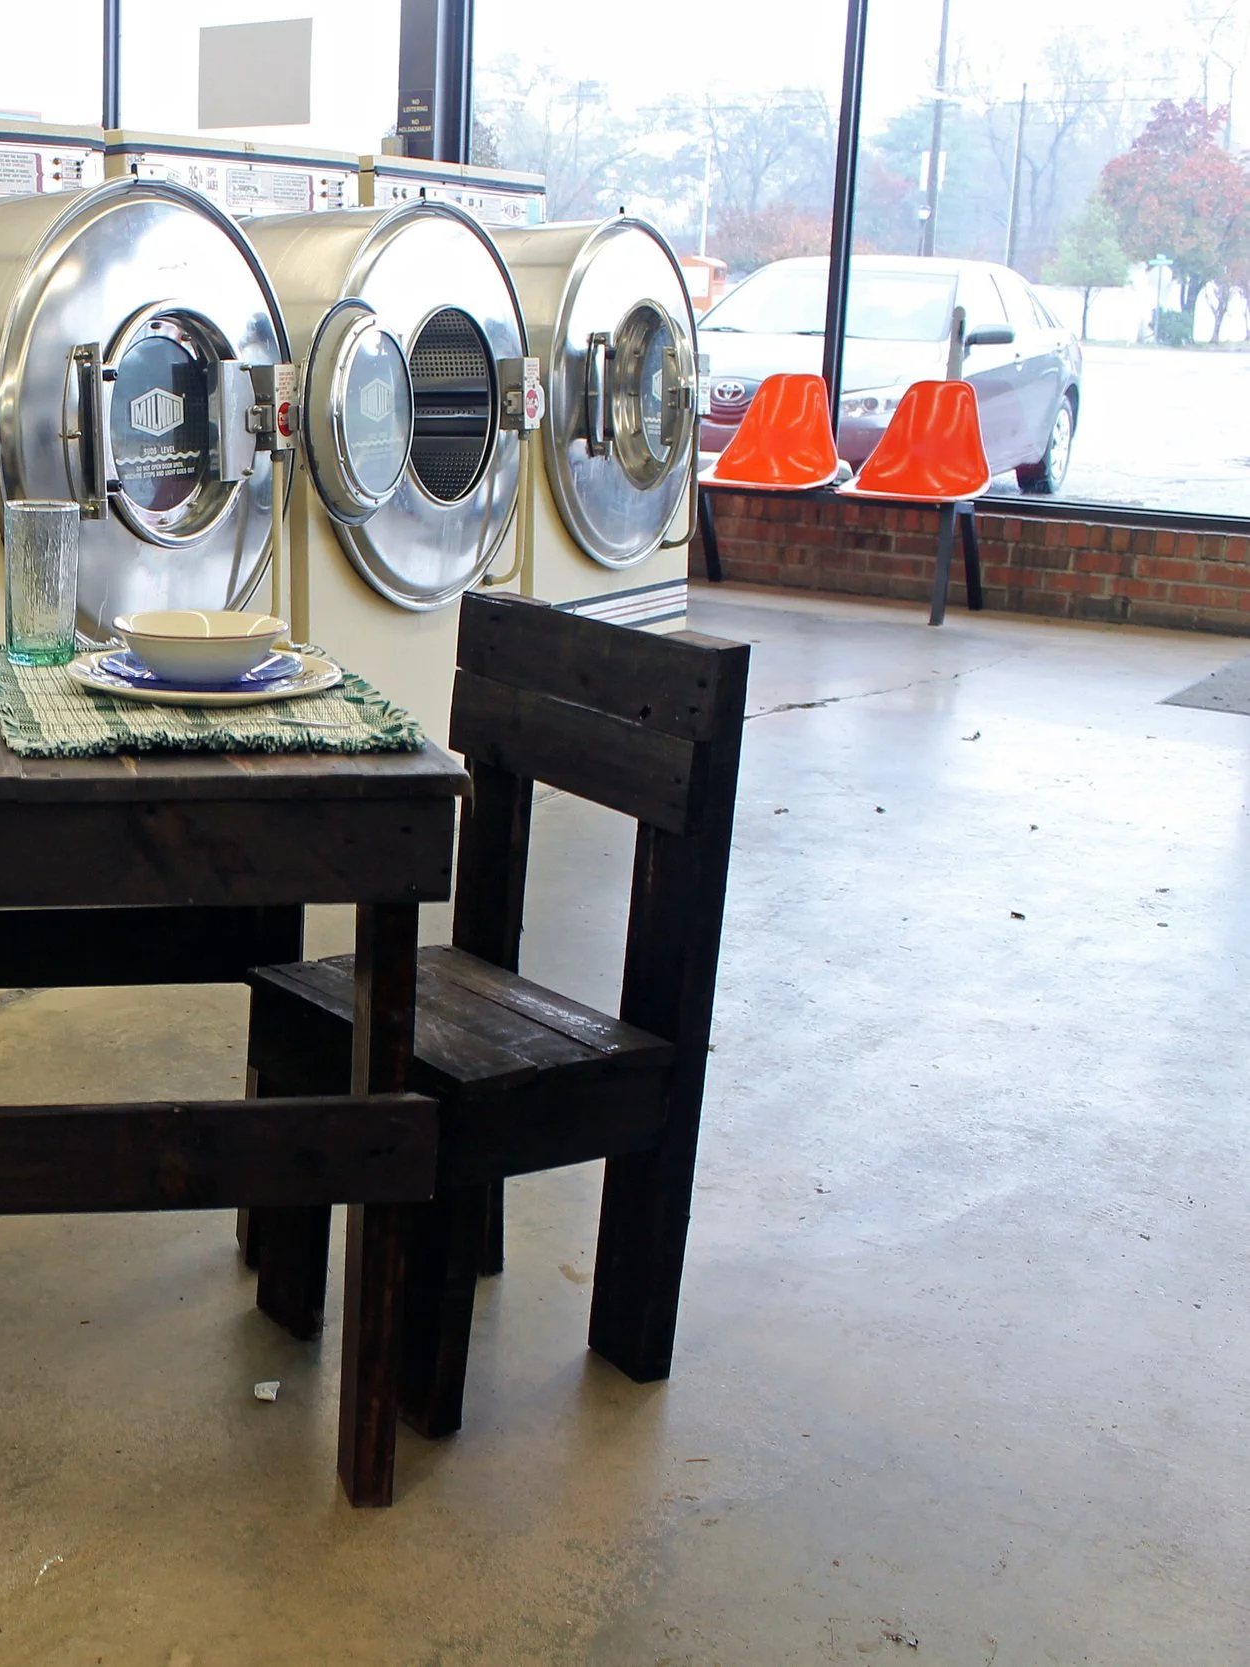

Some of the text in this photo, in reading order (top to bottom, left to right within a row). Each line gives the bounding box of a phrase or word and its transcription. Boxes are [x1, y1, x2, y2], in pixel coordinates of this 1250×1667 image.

[134, 394, 181, 431] MILNOR
[144, 446, 176, 456] SUDS LEVEL
